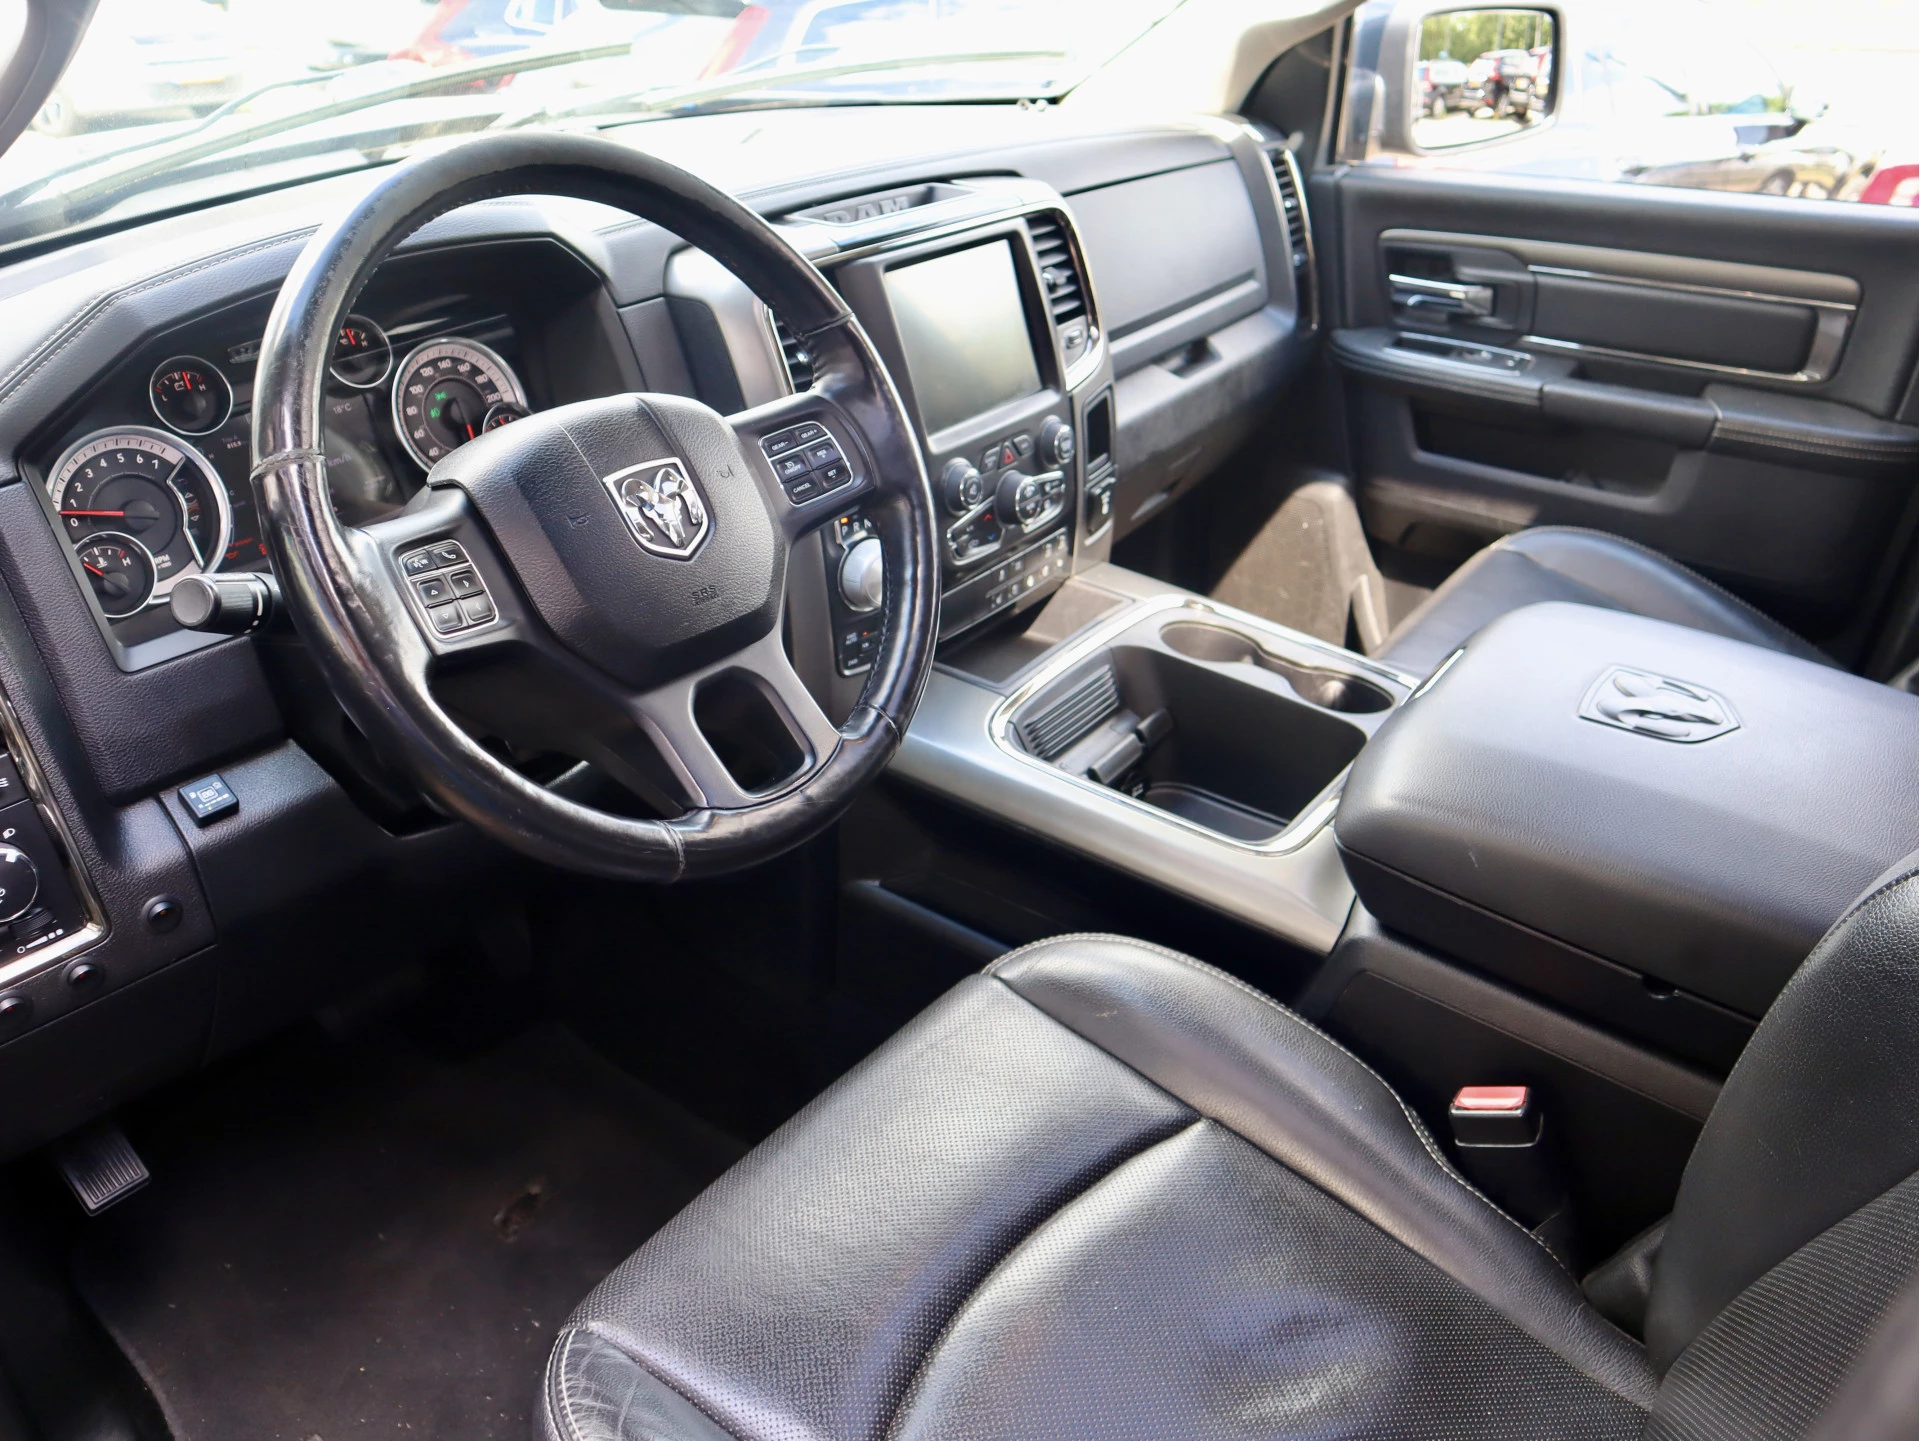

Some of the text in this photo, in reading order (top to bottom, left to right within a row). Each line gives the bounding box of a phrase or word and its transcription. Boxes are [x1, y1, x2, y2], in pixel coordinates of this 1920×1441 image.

[824, 196, 909, 224] RAM
[437, 358, 452, 370] 140
[457, 361, 471, 373] 160
[420, 366, 434, 377] 120
[475, 373, 489, 384] 180
[409, 384, 424, 395] 100
[486, 392, 501, 403] 200
[406, 405, 417, 416] 80
[414, 429, 425, 440] 60
[428, 447, 439, 457] 40
[100, 458, 107, 468] 4
[117, 453, 125, 463] 5
[136, 454, 144, 464] 6
[327, 453, 352, 468] km/h
[152, 460, 159, 469] 7
[85, 468, 93, 478] 3
[74, 482, 83, 492] 2
[793, 482, 811, 493] CANCEL
[70, 499, 77, 508] 1
[71, 518, 78, 527] 0
[842, 525, 848, 536] P
[853, 522, 860, 532] R
[122, 557, 131, 567] H
[154, 554, 170, 565] RPM
[691, 584, 716, 600] SRS
